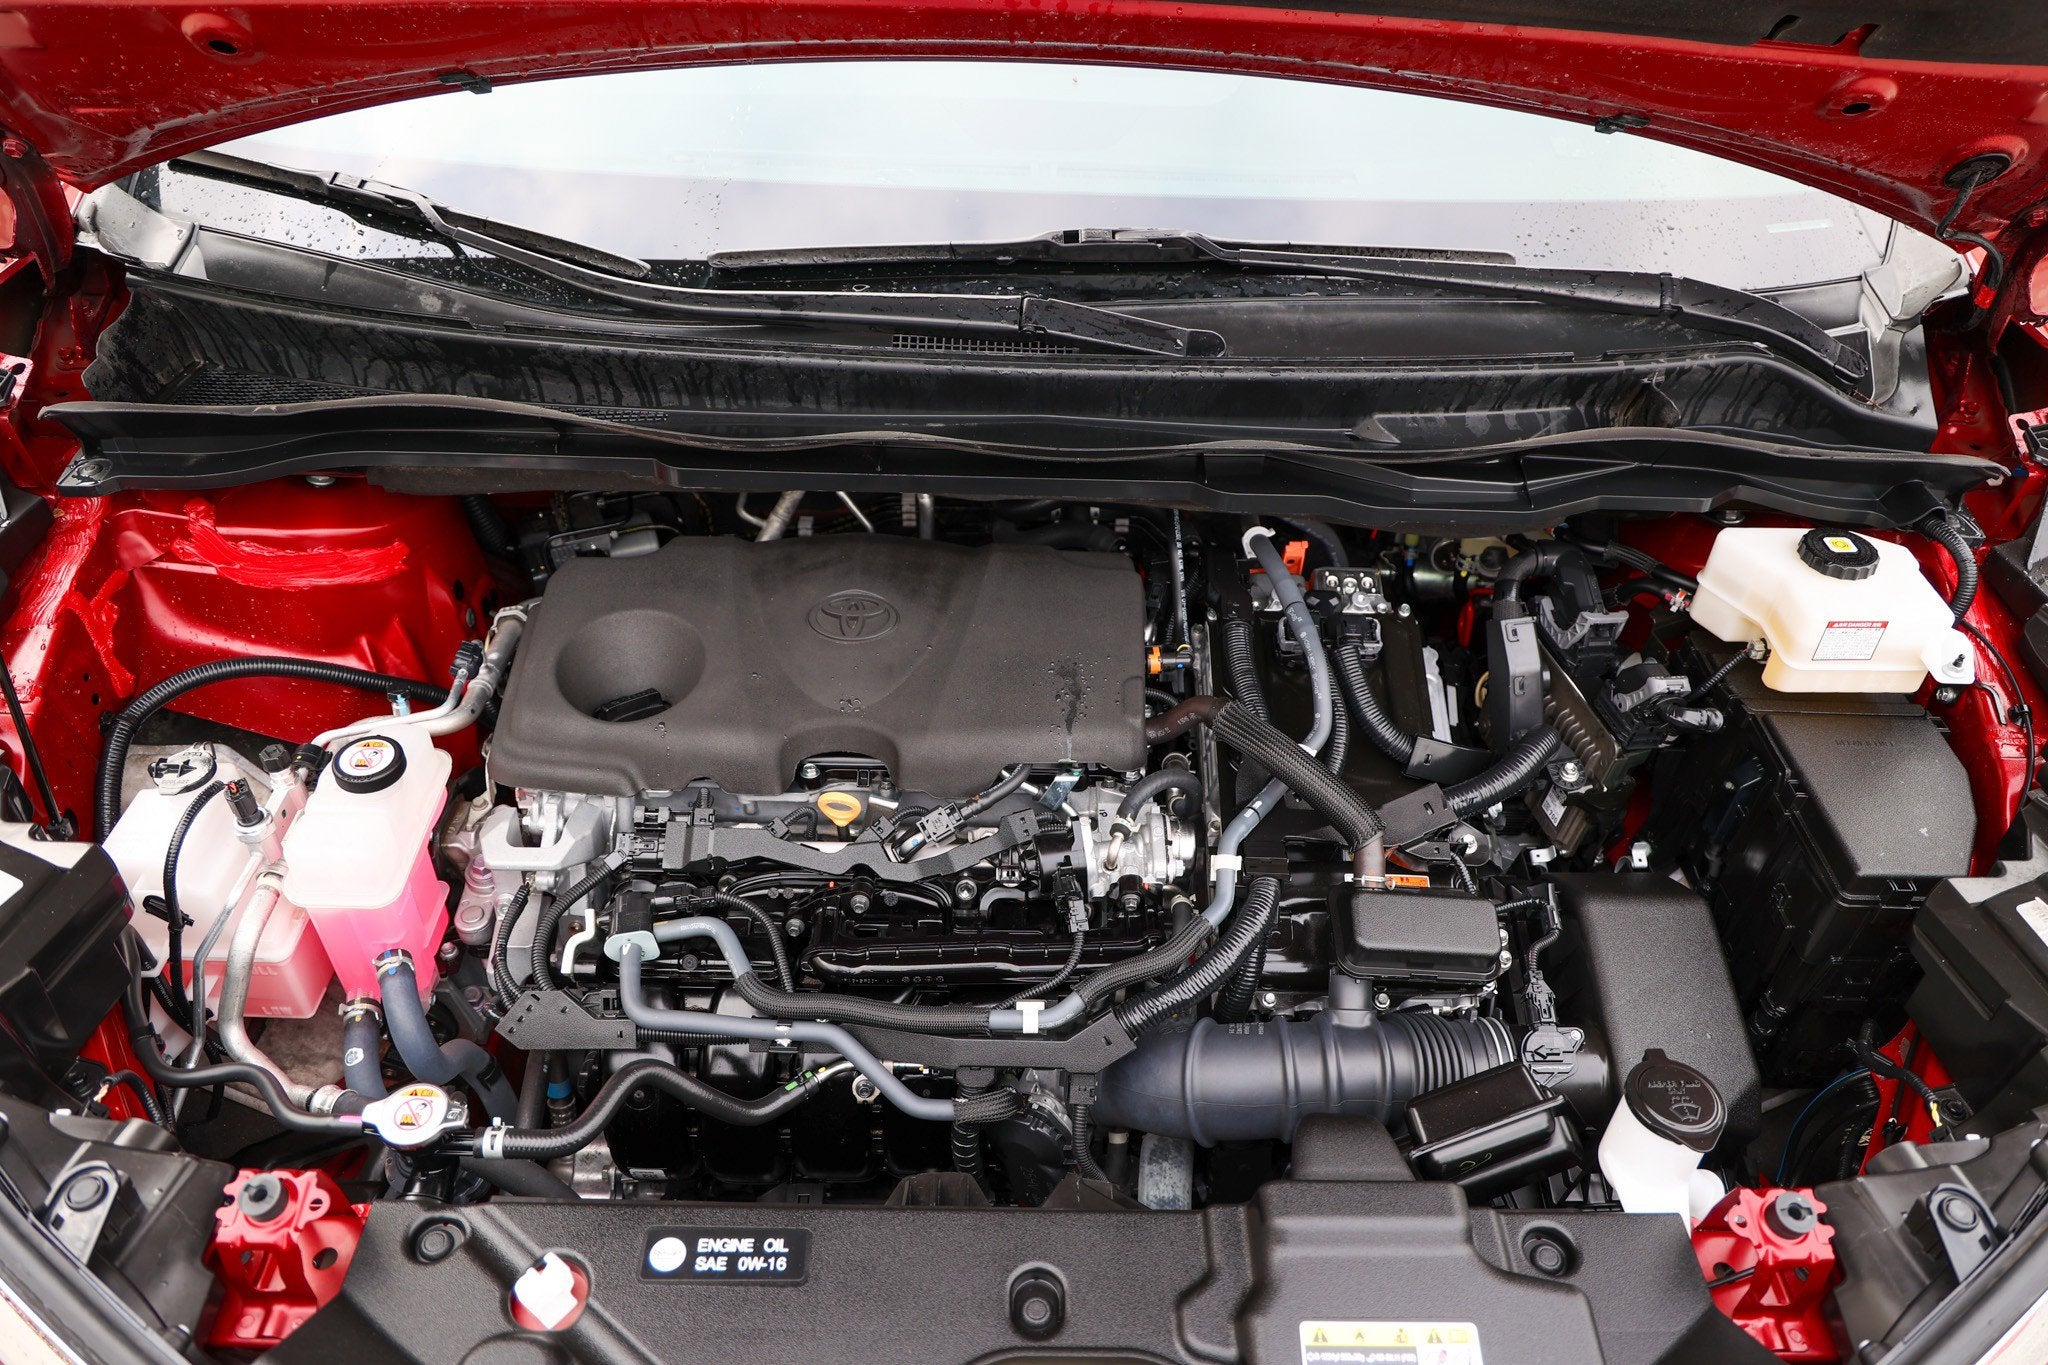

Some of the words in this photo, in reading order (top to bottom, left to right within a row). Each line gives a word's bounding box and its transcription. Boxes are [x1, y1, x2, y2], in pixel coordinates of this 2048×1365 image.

[262, 1006, 292, 1015] LOW
[697, 1238, 754, 1252] ENGINE
[763, 1238, 789, 1252] OIL
[694, 1256, 728, 1271] SAE
[737, 1256, 787, 1271] 0W-16
